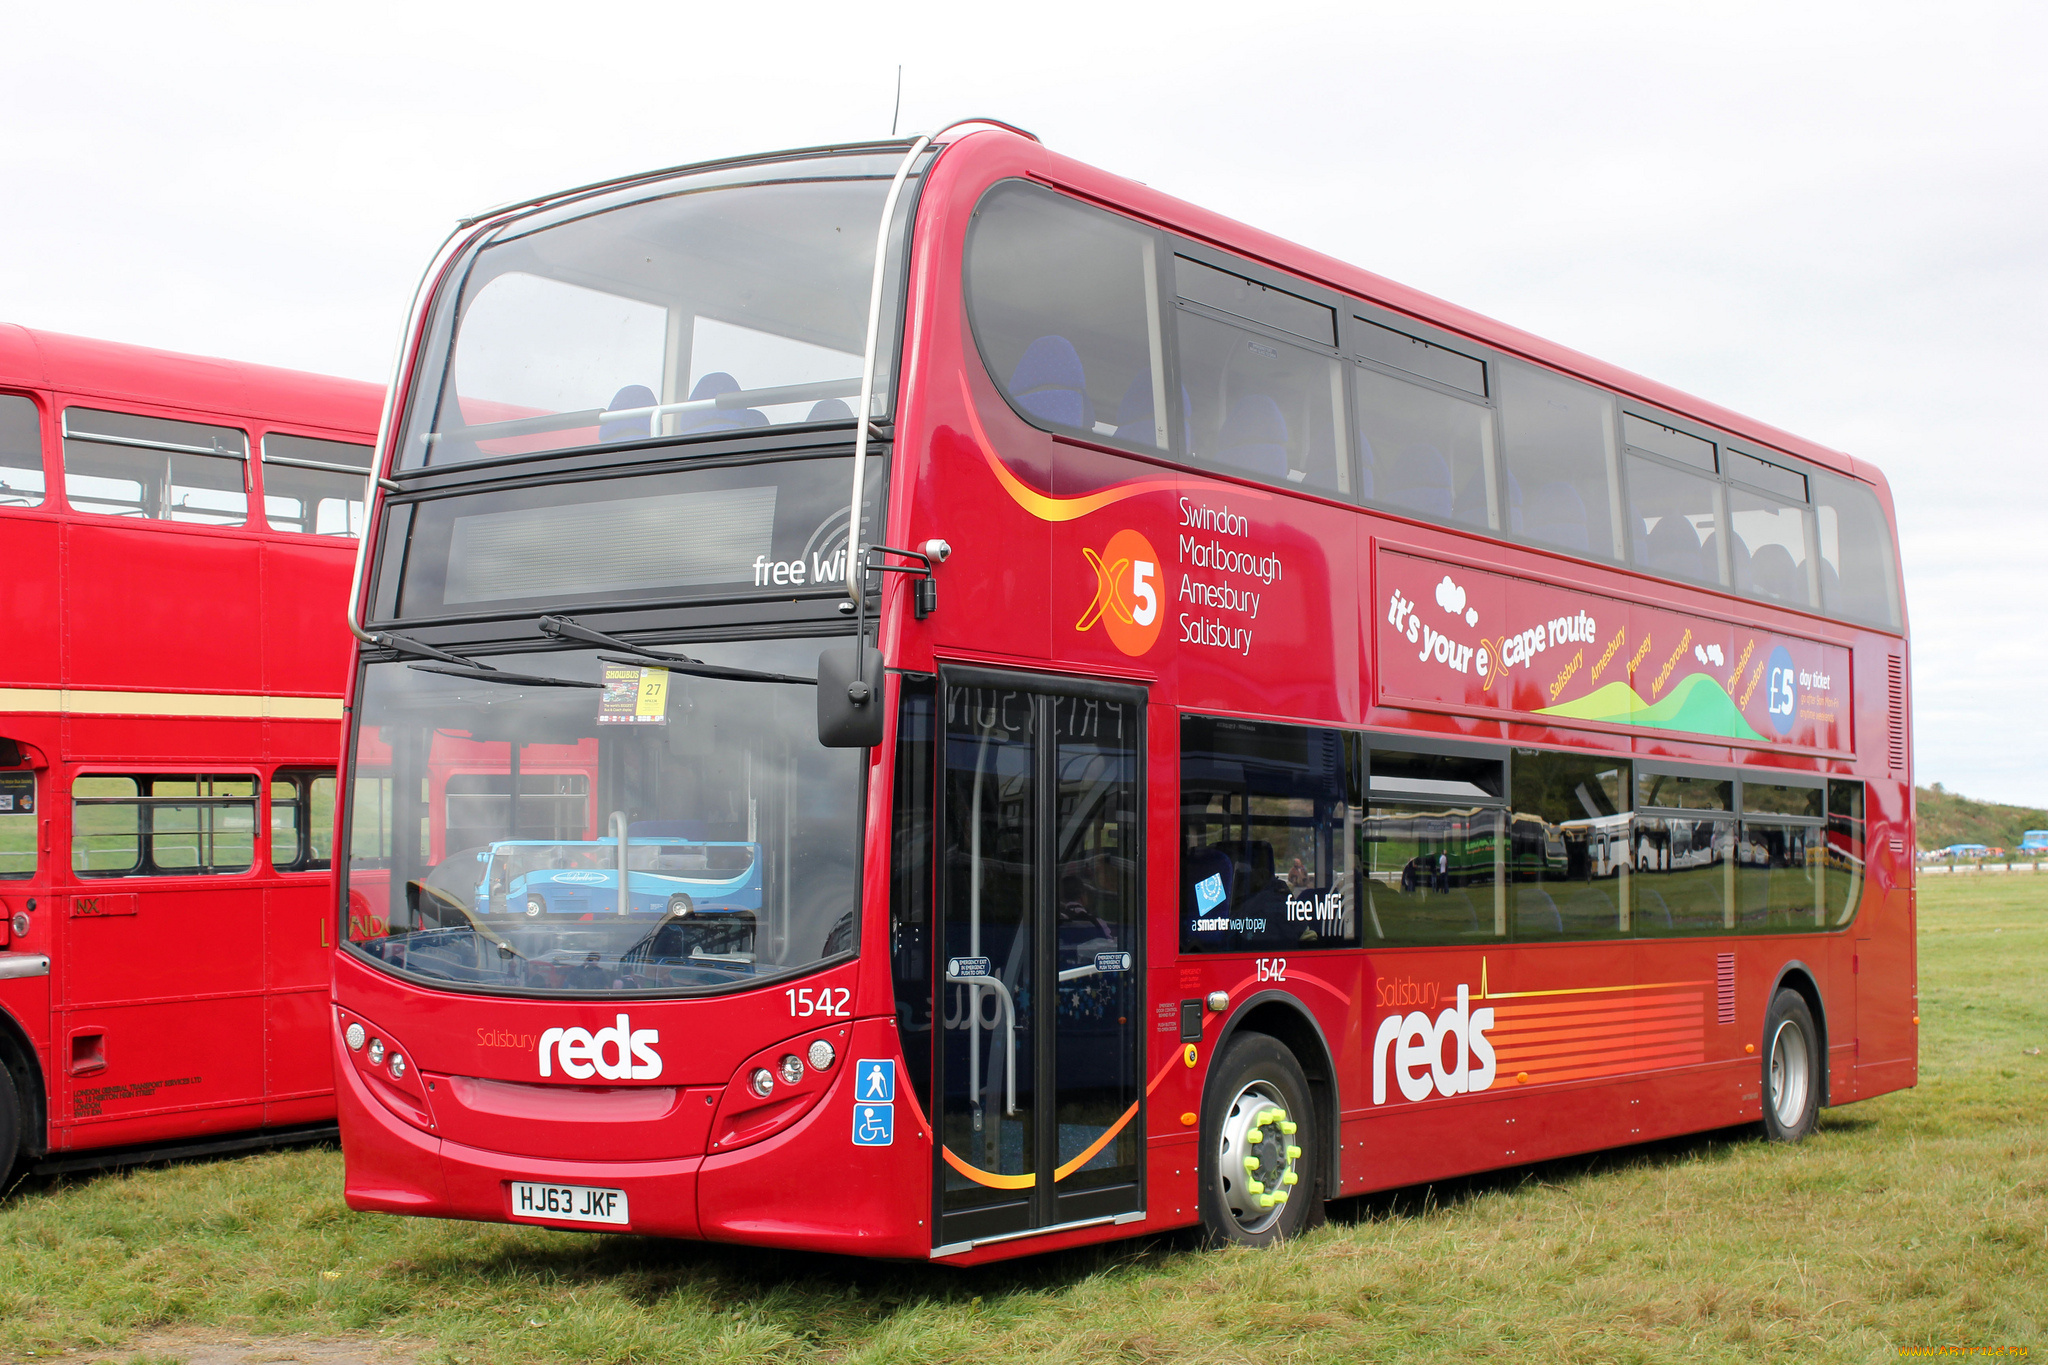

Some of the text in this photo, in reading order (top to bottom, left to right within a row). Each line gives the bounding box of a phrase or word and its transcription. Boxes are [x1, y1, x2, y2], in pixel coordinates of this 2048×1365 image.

[1179, 497, 1248, 538] Swindon
[752, 555, 806, 587] free
[1179, 534, 1282, 585] Marlborough
[1179, 574, 1260, 619] Amesbury
[1179, 612, 1252, 656] Salisbury
[1388, 588, 1421, 644] it's
[1418, 624, 1474, 674] your
[1547, 609, 1596, 648] route
[605, 670, 640, 679] SHOWBUS
[1591, 626, 1625, 685] Amesbury
[1626, 633, 1651, 680] Pewsey
[1652, 628, 1692, 699] Marlborough
[1727, 639, 1755, 696] Chiseldon
[645, 684, 661, 695] 27
[1550, 648, 1583, 702] Salisbury
[1739, 660, 1764, 711] Swindon
[1769, 667, 1794, 716] £5
[1799, 668, 1831, 691] day ticket
[77, 898, 99, 914] NX
[1191, 916, 1267, 933] a smarter way to pay
[1285, 893, 1342, 921] free WiFi
[1255, 958, 1287, 982] 1542
[785, 987, 851, 1017] 1542
[1376, 975, 1440, 1010] Salisbury
[476, 1013, 663, 1080] Salisbury reds
[1373, 984, 1497, 1105] reds
[73, 1076, 202, 1097] LONDON GENERAL TRANSPORT SERVICES LTD
[93, 1093, 119, 1101] MERTON
[136, 1089, 156, 1097] STREET
[73, 1101, 101, 1111] LONDON
[521, 1186, 618, 1217] HJ63 JKF
